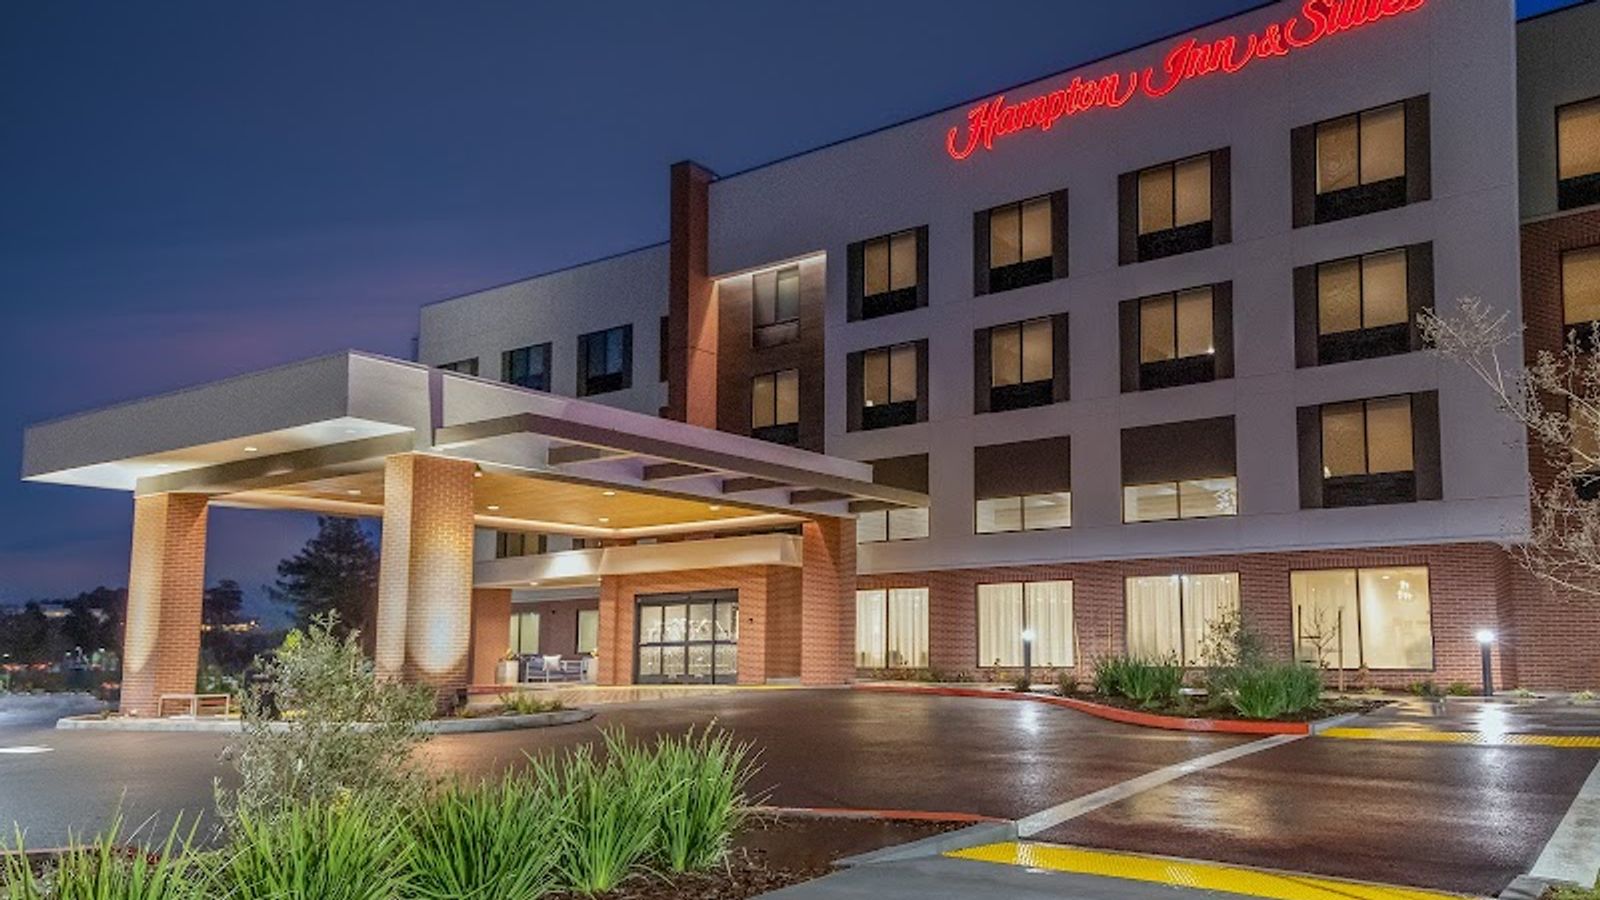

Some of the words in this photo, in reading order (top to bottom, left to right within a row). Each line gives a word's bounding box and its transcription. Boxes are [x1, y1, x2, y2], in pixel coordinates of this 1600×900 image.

[947, 72, 1137, 160] Hampton
[1143, 34, 1257, 97] Inn
[1256, 24, 1288, 57] &
